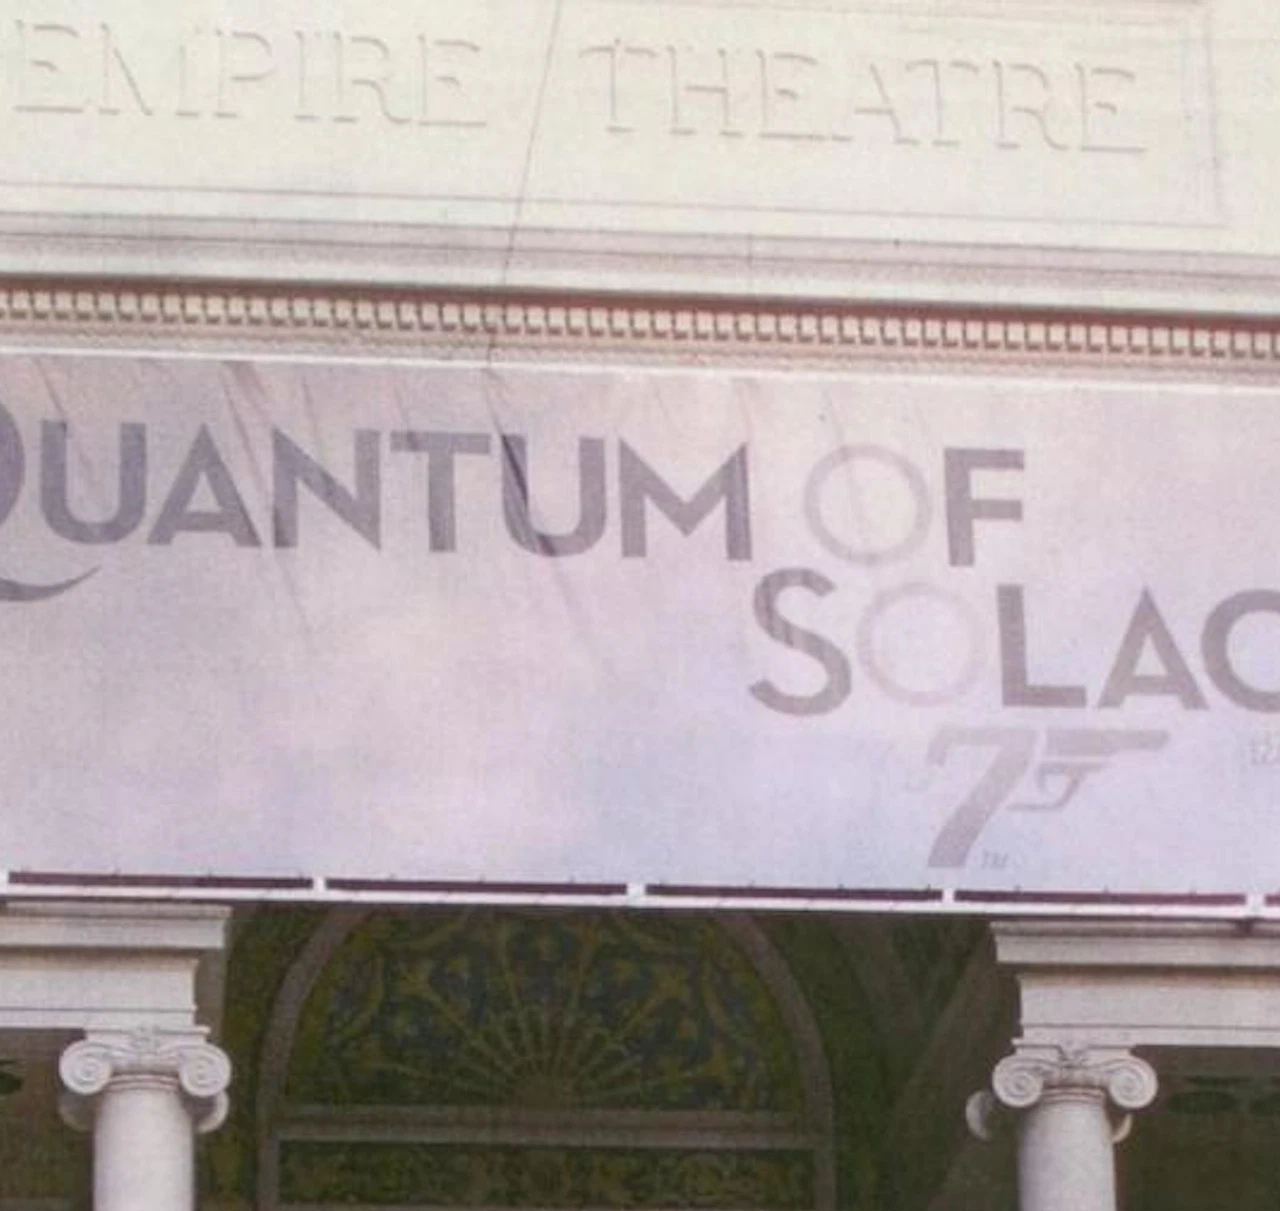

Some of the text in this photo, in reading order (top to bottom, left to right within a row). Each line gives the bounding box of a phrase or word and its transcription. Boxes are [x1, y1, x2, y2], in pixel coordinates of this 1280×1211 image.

[12, 18, 1148, 155] EMPIRE THEATRE
[803, 442, 1025, 568] OF
